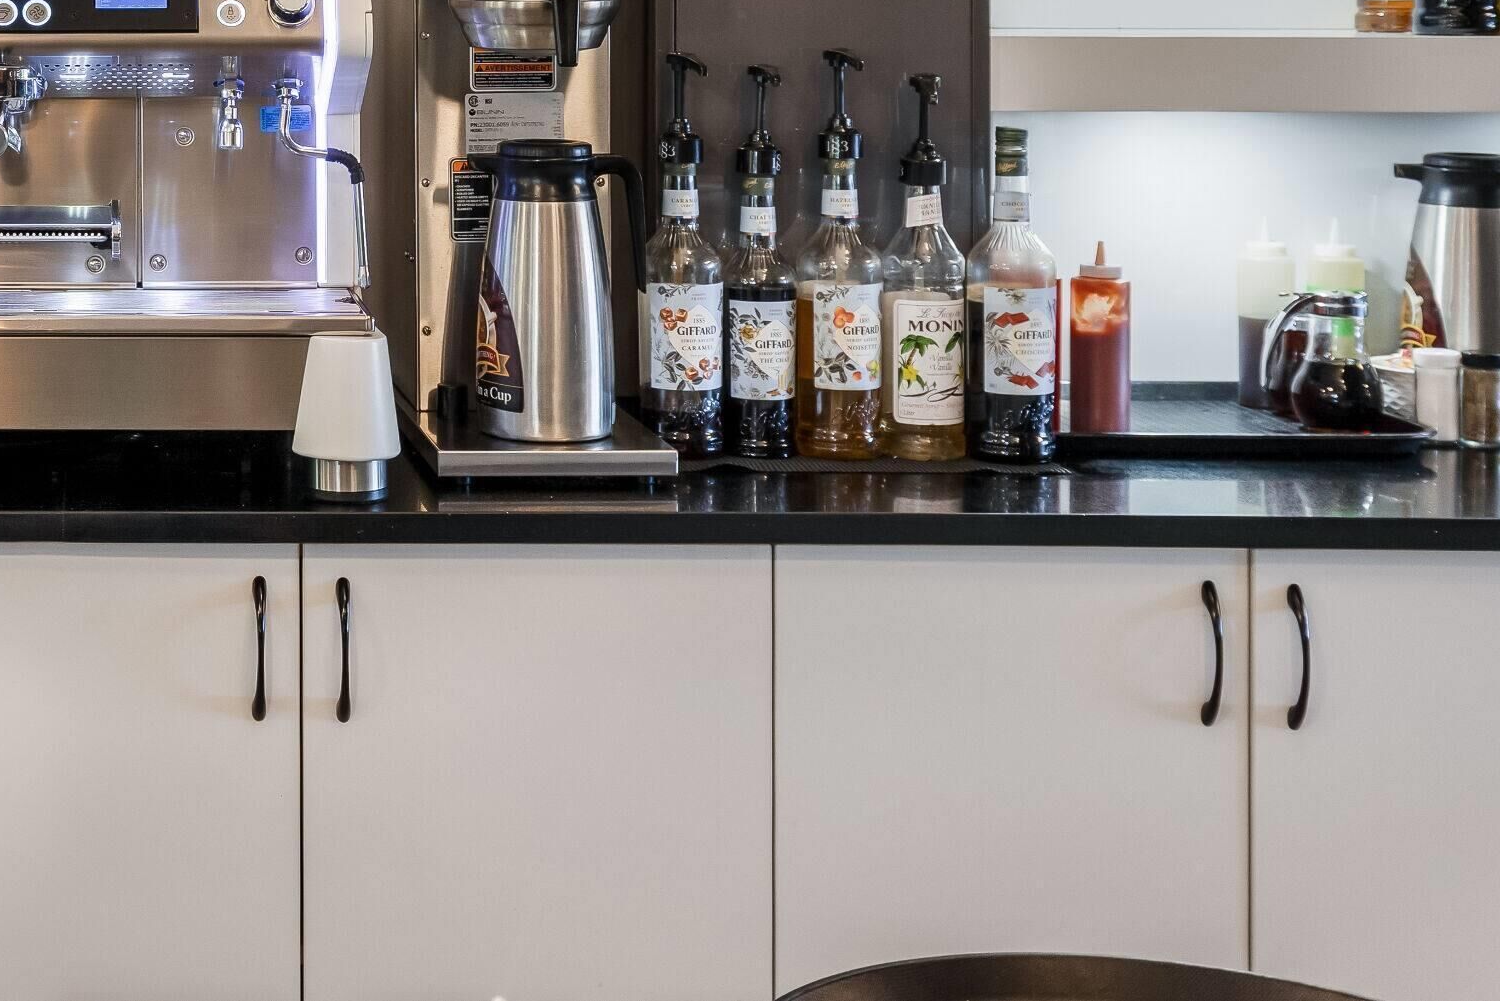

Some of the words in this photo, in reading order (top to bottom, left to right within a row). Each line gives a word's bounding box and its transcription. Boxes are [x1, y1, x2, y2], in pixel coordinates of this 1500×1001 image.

[485, 64, 551, 72] AVERTISSEMENT
[676, 325, 717, 336] GIFFARD
[842, 325, 880, 336] GIFFARD
[755, 338, 793, 349] GIFFARD
[483, 387, 489, 397] a
[489, 386, 512, 405] Cup
